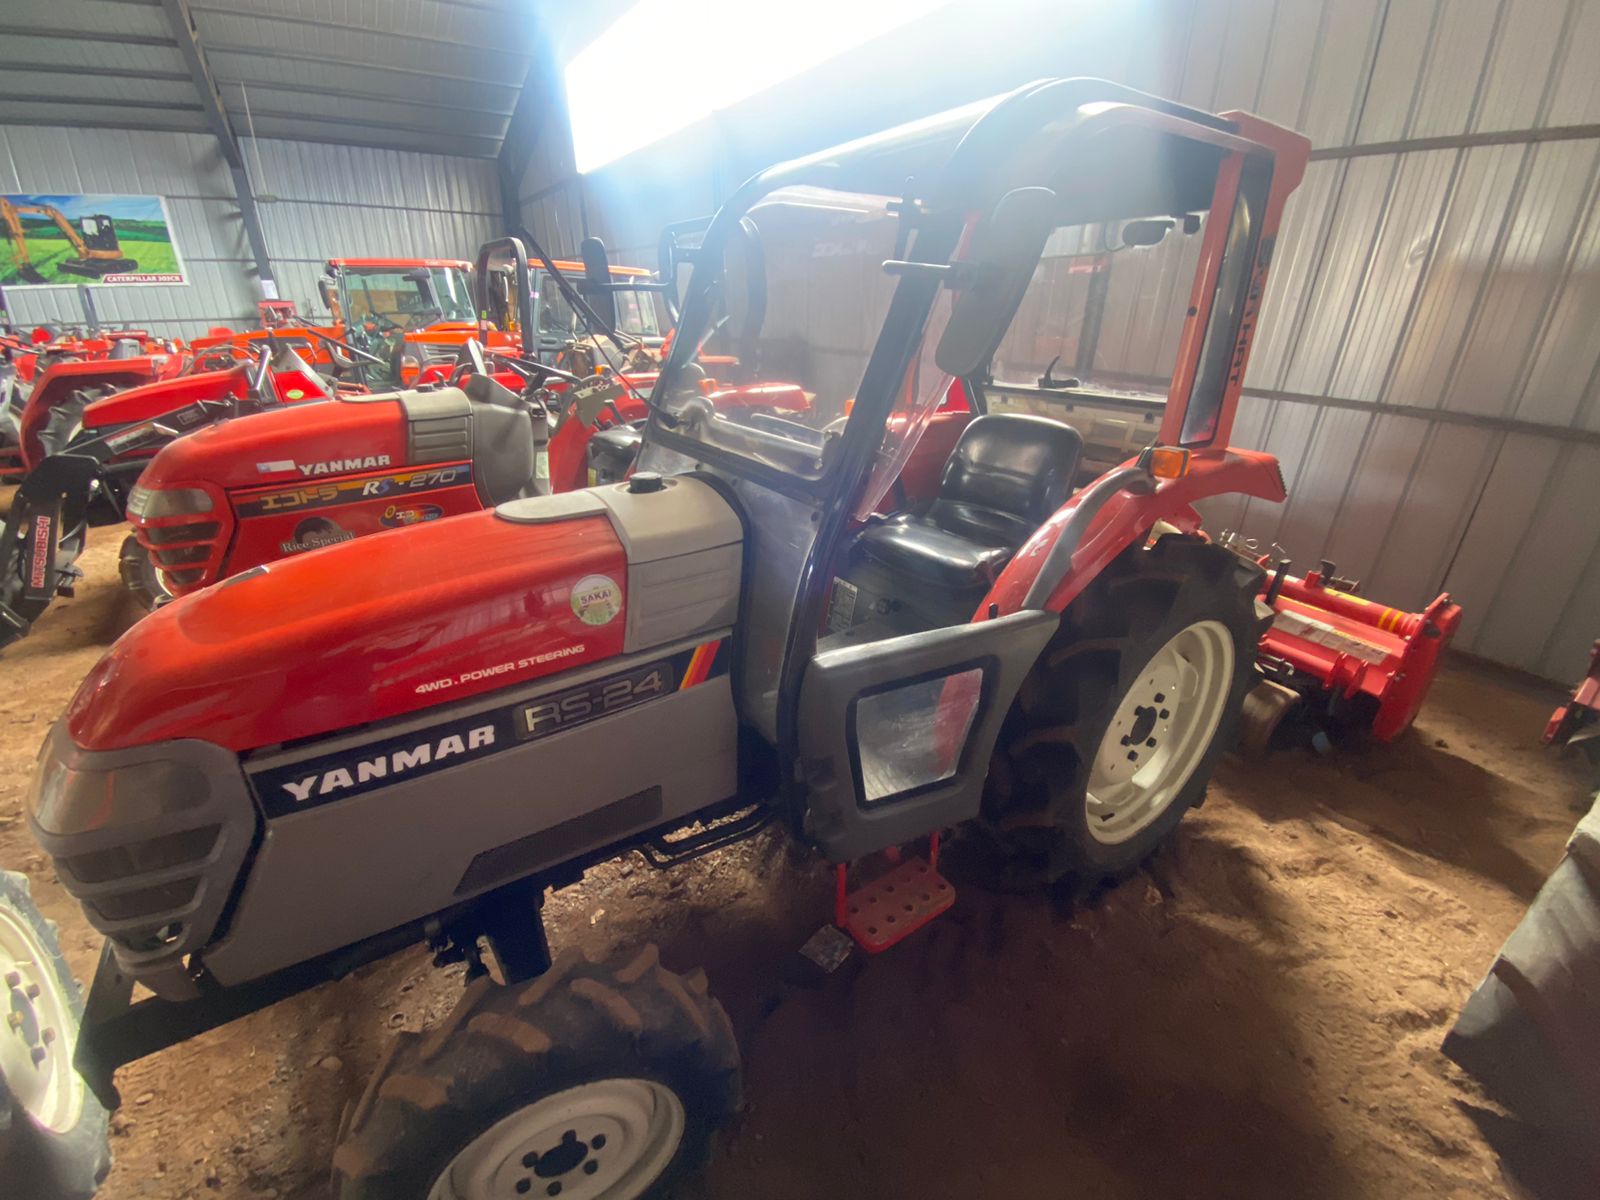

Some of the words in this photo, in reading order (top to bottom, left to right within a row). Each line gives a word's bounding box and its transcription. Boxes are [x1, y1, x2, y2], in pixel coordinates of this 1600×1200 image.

[298, 455, 391, 476] YANMAR
[259, 485, 339, 510] エコトラ
[31, 515, 51, 589] MITSUBISHI
[281, 541, 310, 553] Rice
[311, 531, 355, 548] Special
[580, 589, 612, 605] SAKAI
[459, 662, 516, 684] POWER
[518, 644, 586, 669] STEERING
[525, 671, 663, 733] RS-24
[281, 724, 496, 802] YANMAR
